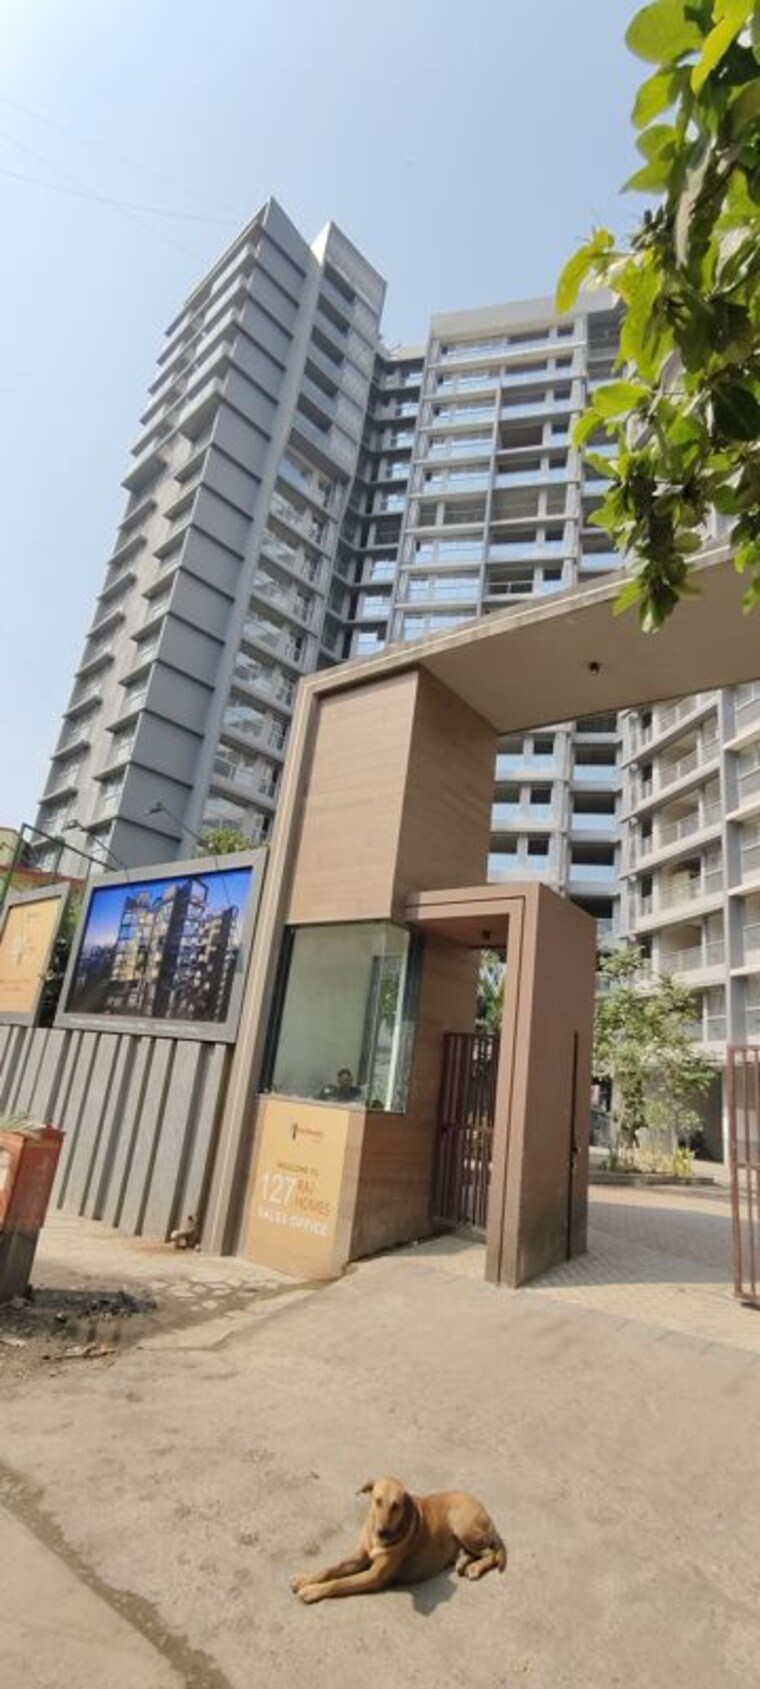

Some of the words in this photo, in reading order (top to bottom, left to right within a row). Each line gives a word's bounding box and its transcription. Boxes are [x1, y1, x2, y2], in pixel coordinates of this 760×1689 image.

[261, 1172, 297, 1207] 127
[256, 1206, 288, 1226] SALES
[288, 1214, 329, 1237] OFFICE
[294, 1195, 331, 1217] HOMES
